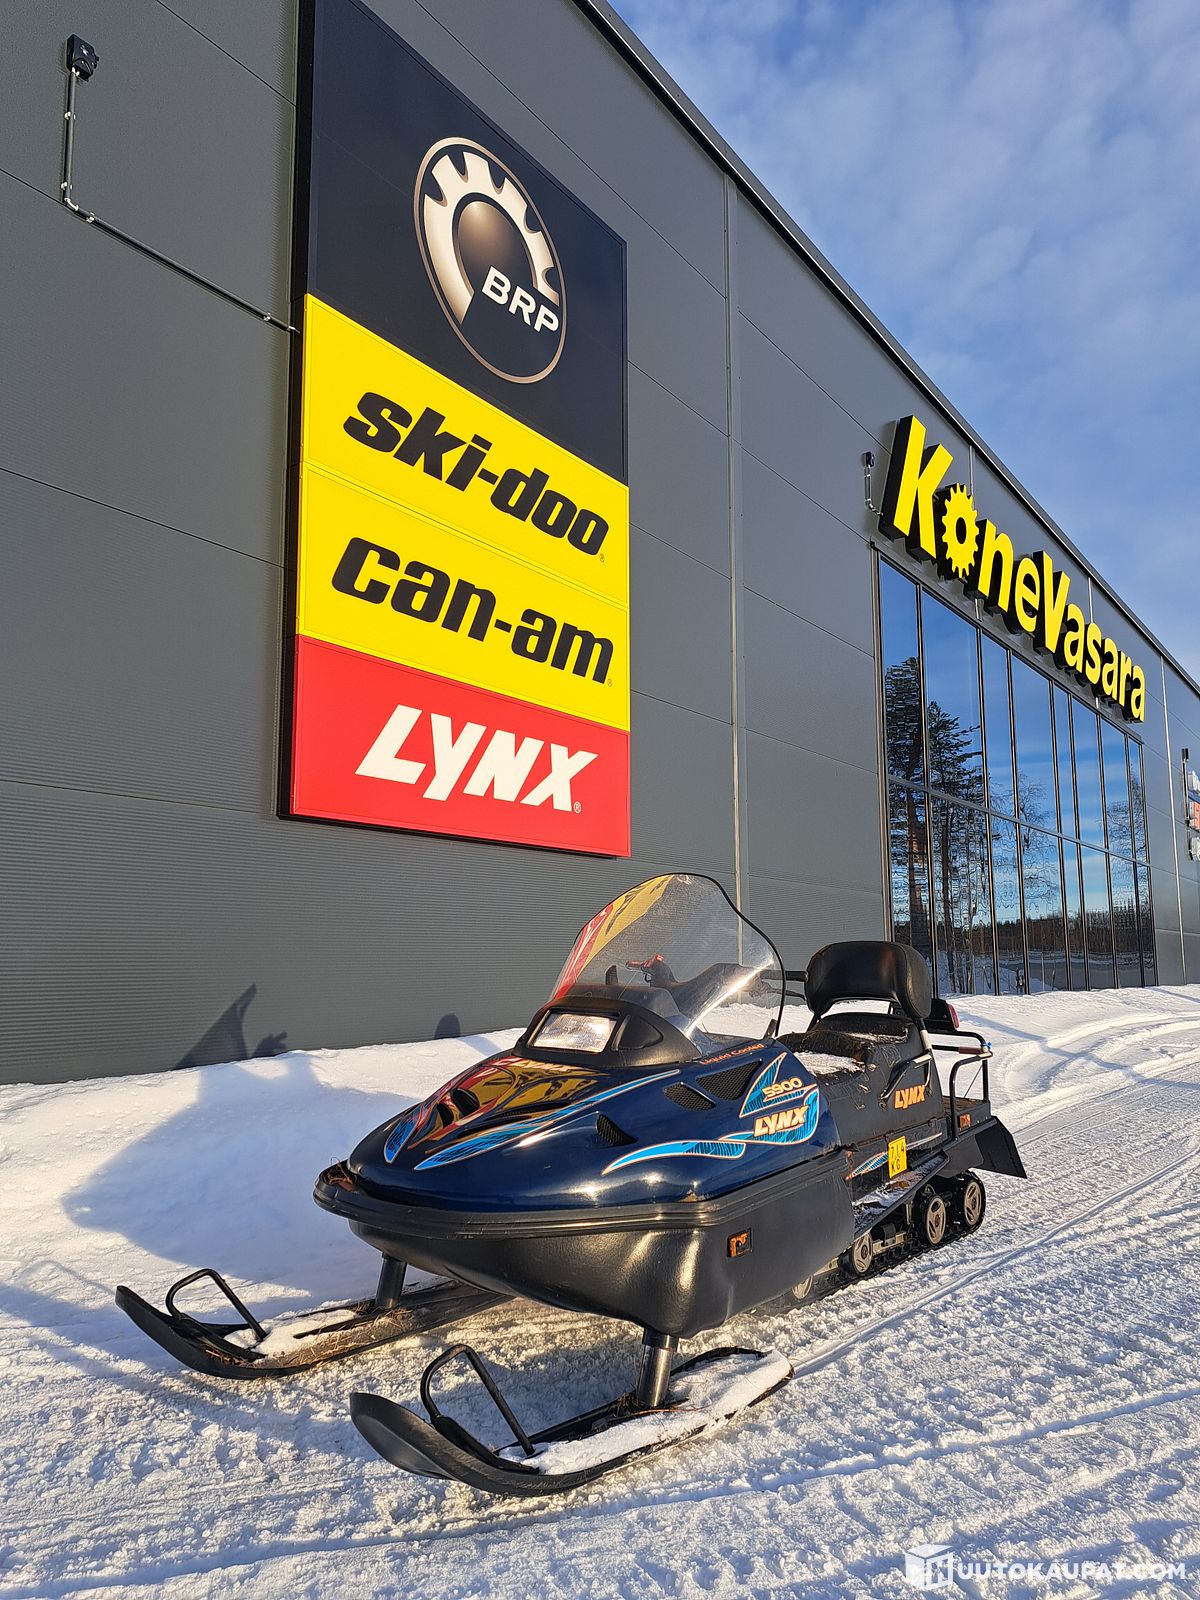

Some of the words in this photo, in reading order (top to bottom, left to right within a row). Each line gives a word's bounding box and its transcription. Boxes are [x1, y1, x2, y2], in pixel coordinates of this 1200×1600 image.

[481, 266, 559, 332] BRP
[343, 392, 609, 556] ski-doo
[892, 415, 1146, 722] KoneVasara
[355, 704, 599, 812] LYNX
[762, 1077, 802, 1097] 5900
[894, 1085, 925, 1109] LYNX
[754, 1105, 808, 1137] LYNX
